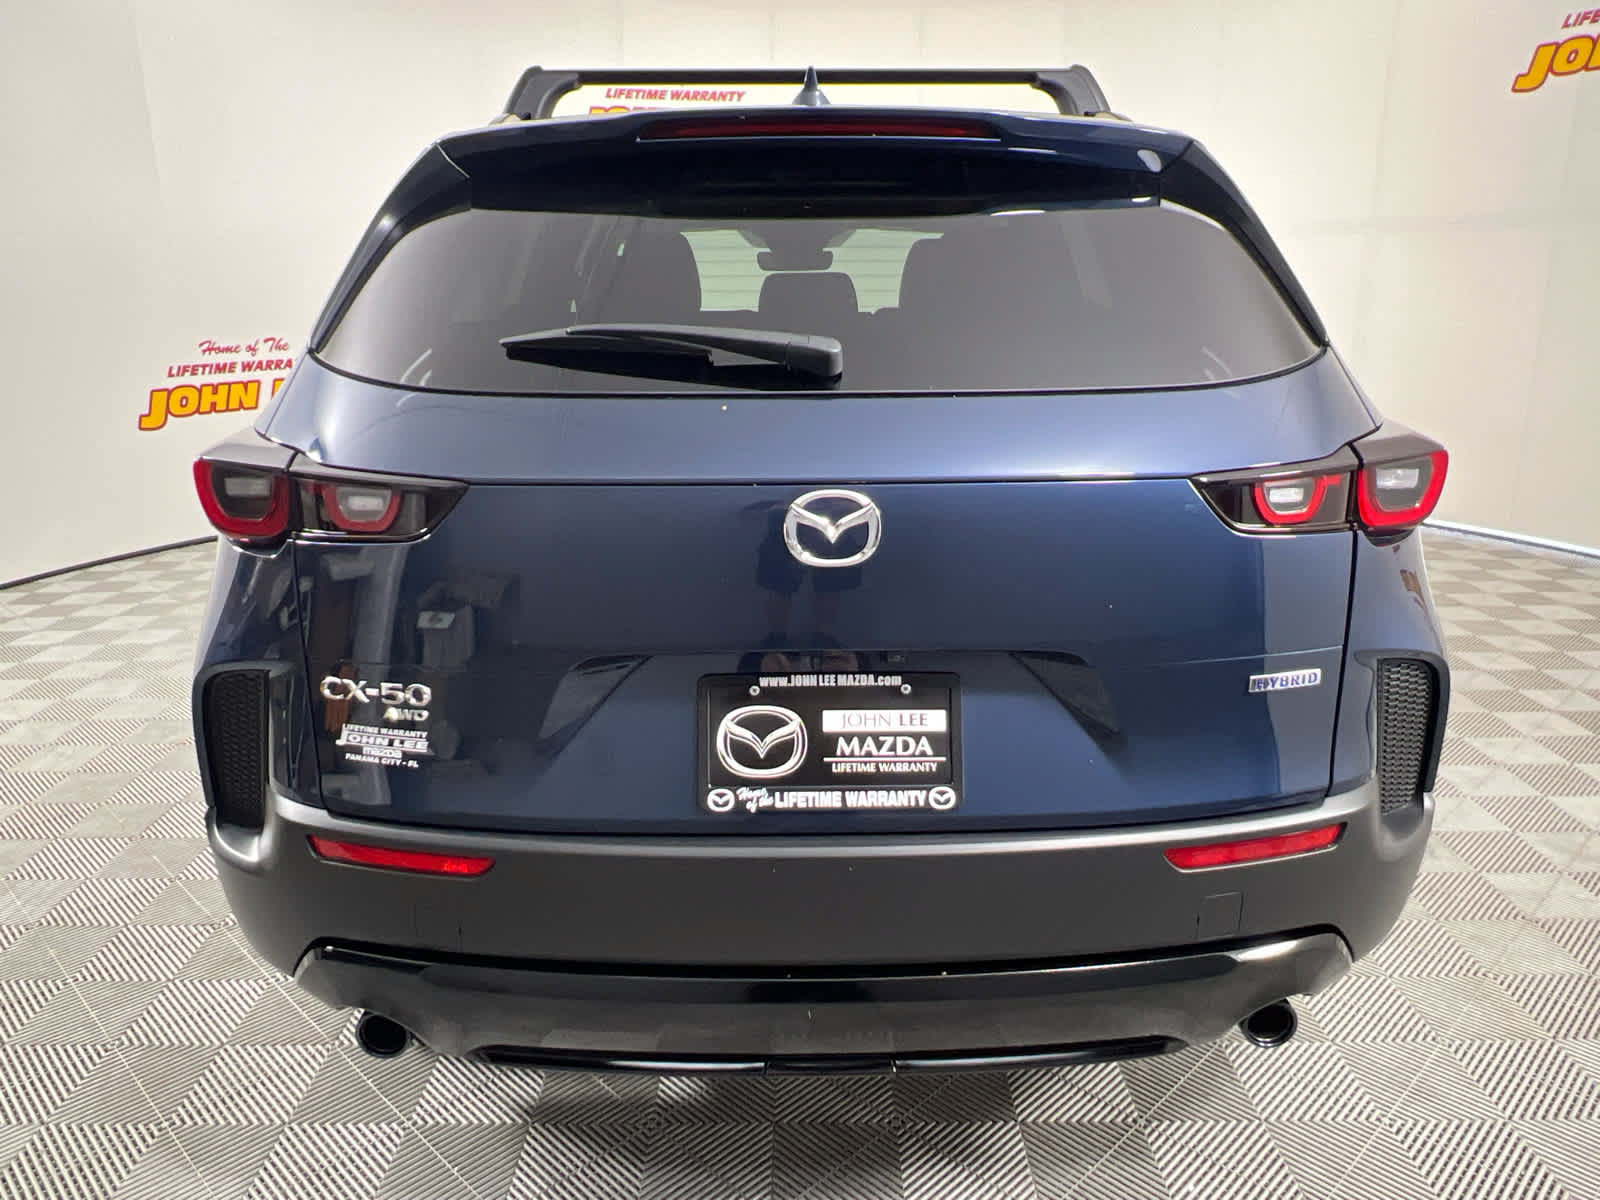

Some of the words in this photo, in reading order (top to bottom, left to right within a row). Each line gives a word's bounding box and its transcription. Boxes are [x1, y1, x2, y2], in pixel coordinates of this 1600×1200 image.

[605, 88, 667, 100] LIFETIME
[670, 89, 745, 102] WARRANTY
[198, 340, 241, 355] Home
[245, 339, 259, 356] of
[263, 337, 289, 352] The
[167, 362, 237, 378] LIFETIME
[241, 358, 293, 372] WARRA
[138, 379, 261, 431] JOHN
[818, 675, 836, 686] LEE
[837, 674, 902, 686] MAZDA.com
[1255, 672, 1318, 689] HYBRID
[320, 676, 432, 706] CX-50
[383, 707, 429, 721] AWD
[842, 712, 892, 728] JOHN
[899, 713, 928, 727] LEE
[335, 729, 390, 746] JOHN
[393, 739, 429, 750] LEE
[380, 727, 428, 738] WARRANTY
[836, 735, 934, 756] MAZDA
[345, 753, 380, 763] PANAMA
[381, 758, 402, 766] CITY
[831, 762, 877, 773] LIFETIME
[878, 762, 938, 773] WARRANTY
[774, 791, 842, 808] LIFETIME
[845, 789, 927, 808] WARRANTY
